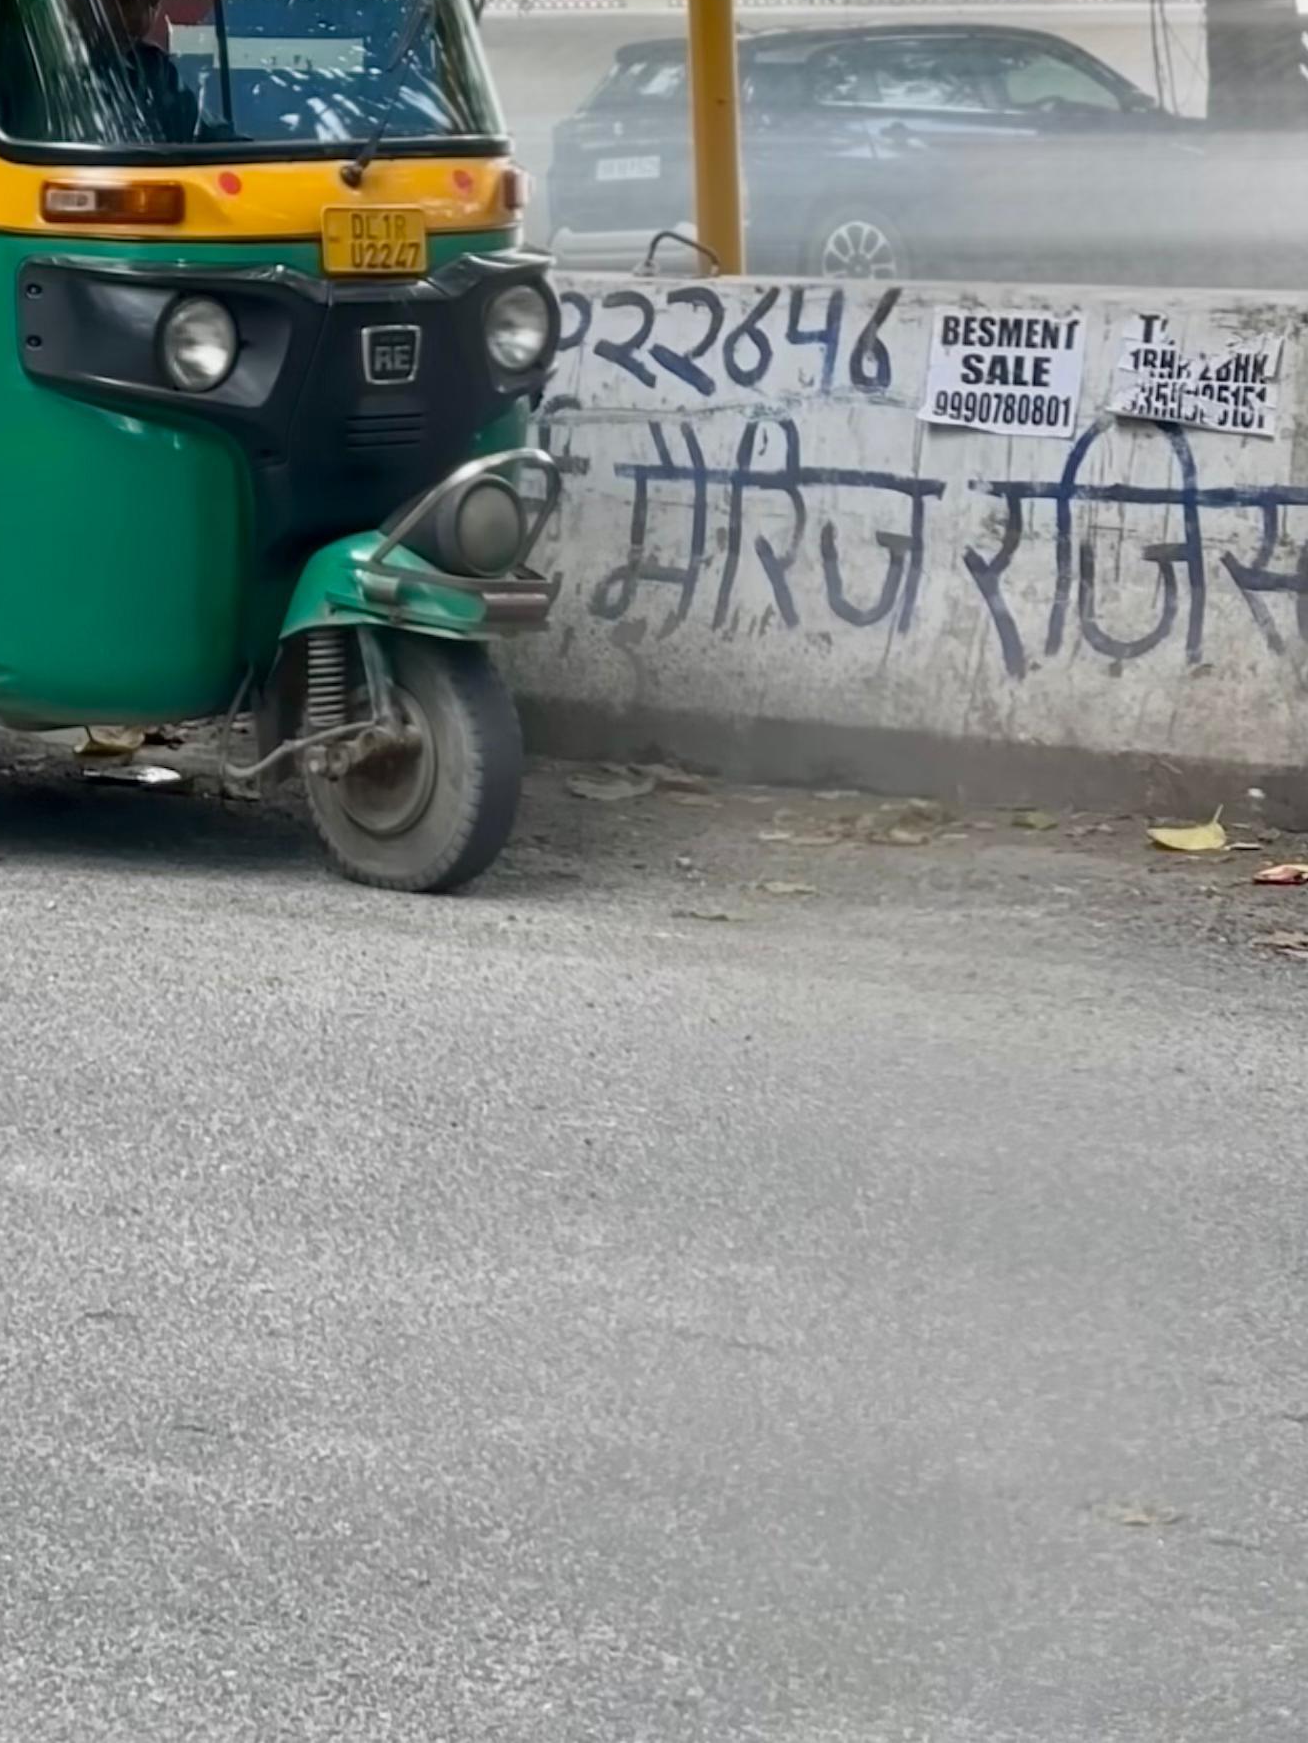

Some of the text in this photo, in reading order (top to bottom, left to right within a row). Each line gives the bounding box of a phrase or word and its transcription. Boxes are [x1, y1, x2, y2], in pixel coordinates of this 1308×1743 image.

[941, 315, 1080, 350] BESMENT
[374, 345, 412, 372] RE
[960, 353, 1052, 387] SALE
[931, 389, 1072, 427] 9990780801
